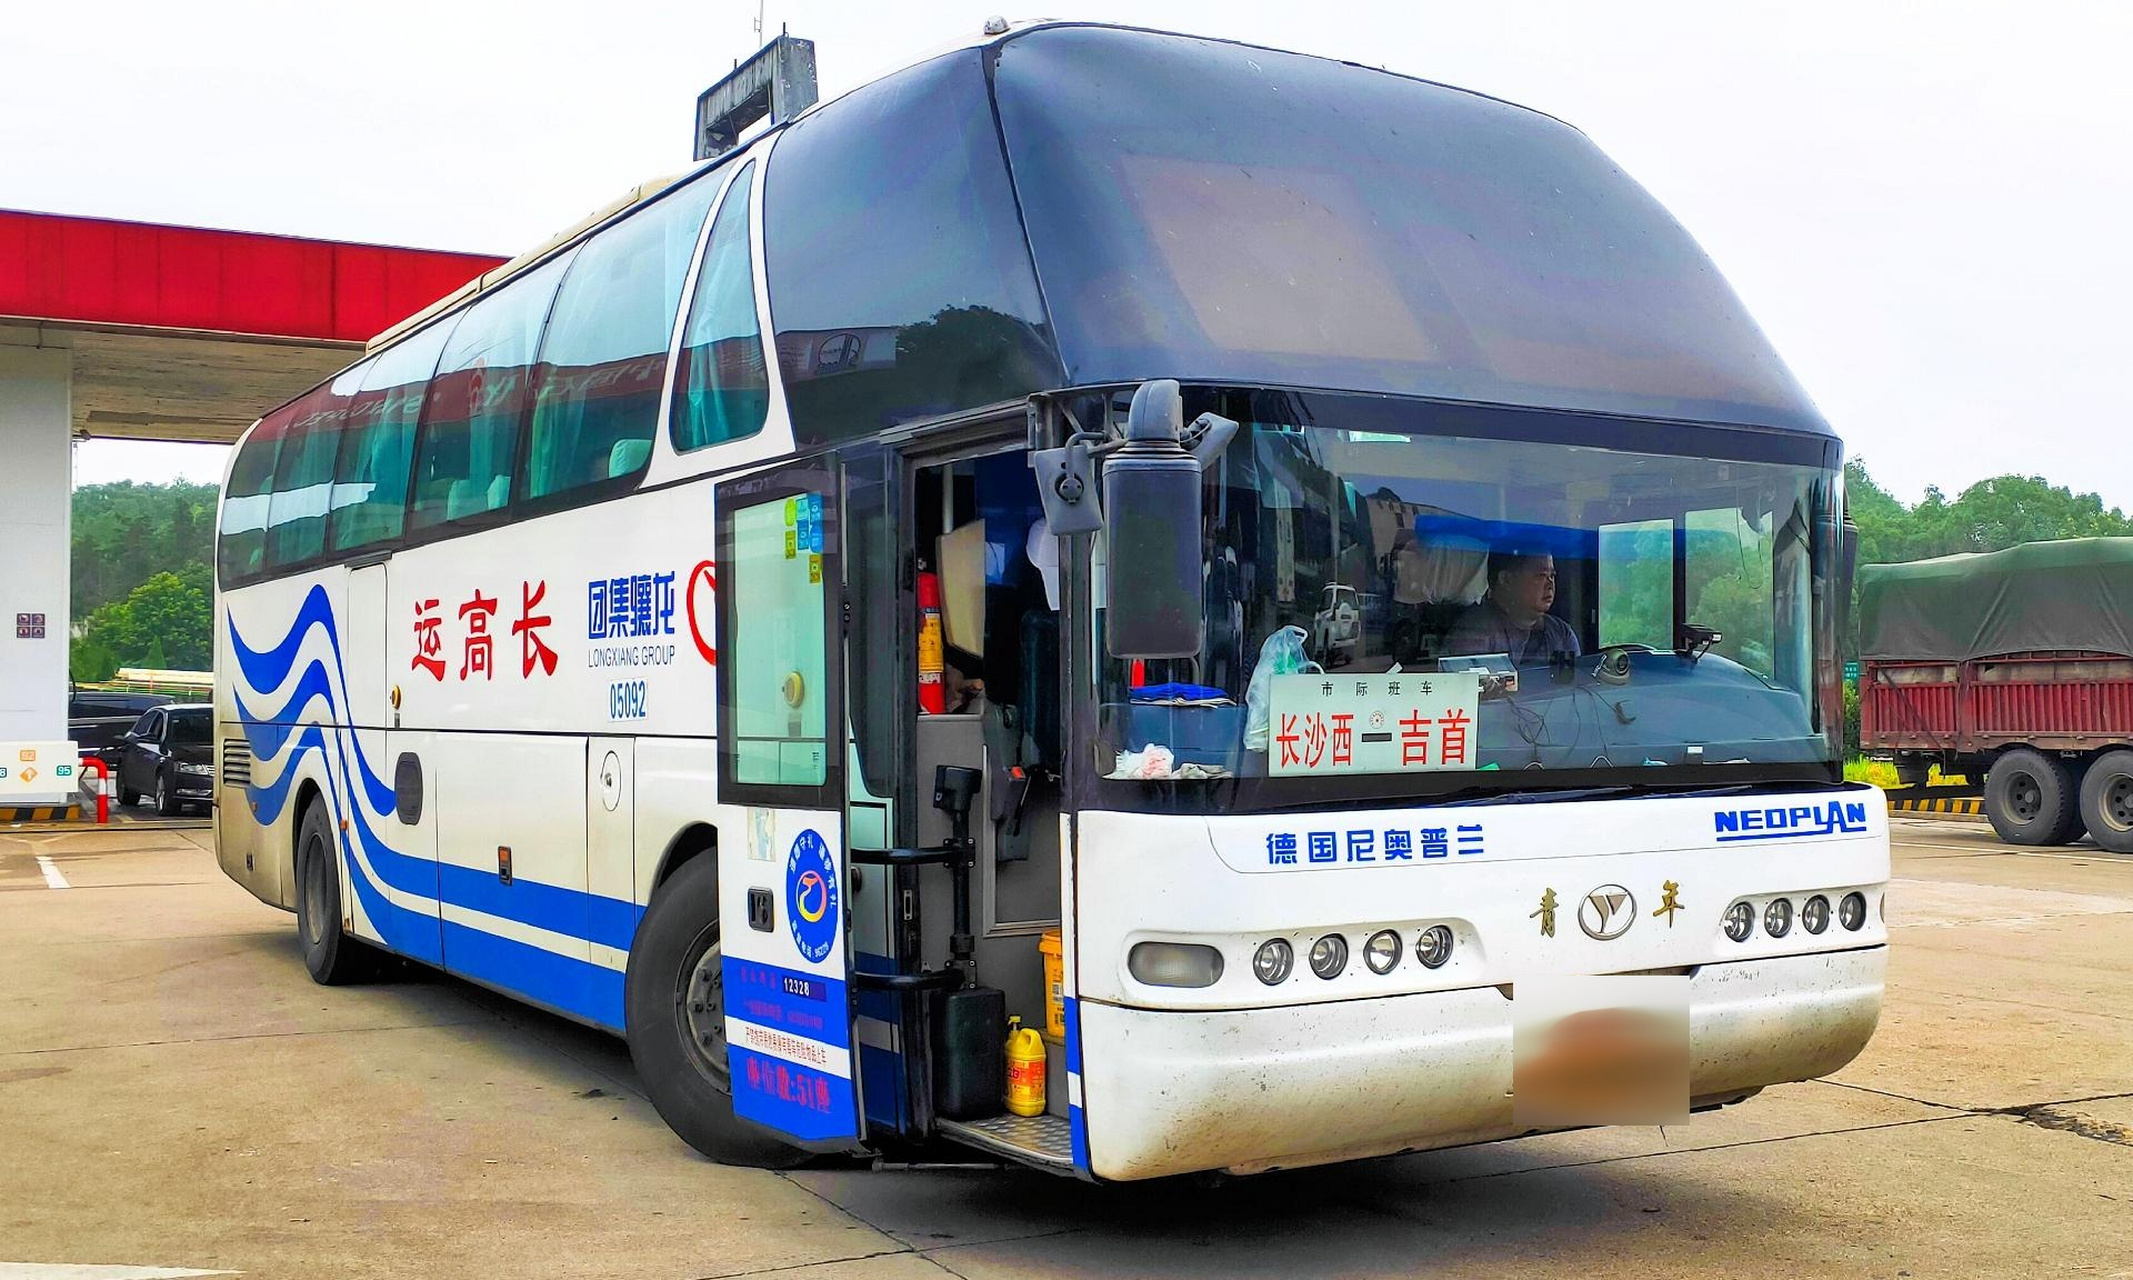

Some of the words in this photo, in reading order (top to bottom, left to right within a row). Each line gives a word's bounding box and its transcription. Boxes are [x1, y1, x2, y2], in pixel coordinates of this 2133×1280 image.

[588, 647, 639, 668] LONGXIANG
[641, 645, 675, 667] GROUP
[610, 680, 646, 718] 05092
[1321, 681, 1433, 697] 市际班车
[58, 767, 71, 775] 95
[1714, 801, 1866, 836] NEOPLAN
[1266, 824, 1484, 865] 德国尼奥普兰
[784, 977, 810, 997] 12328
